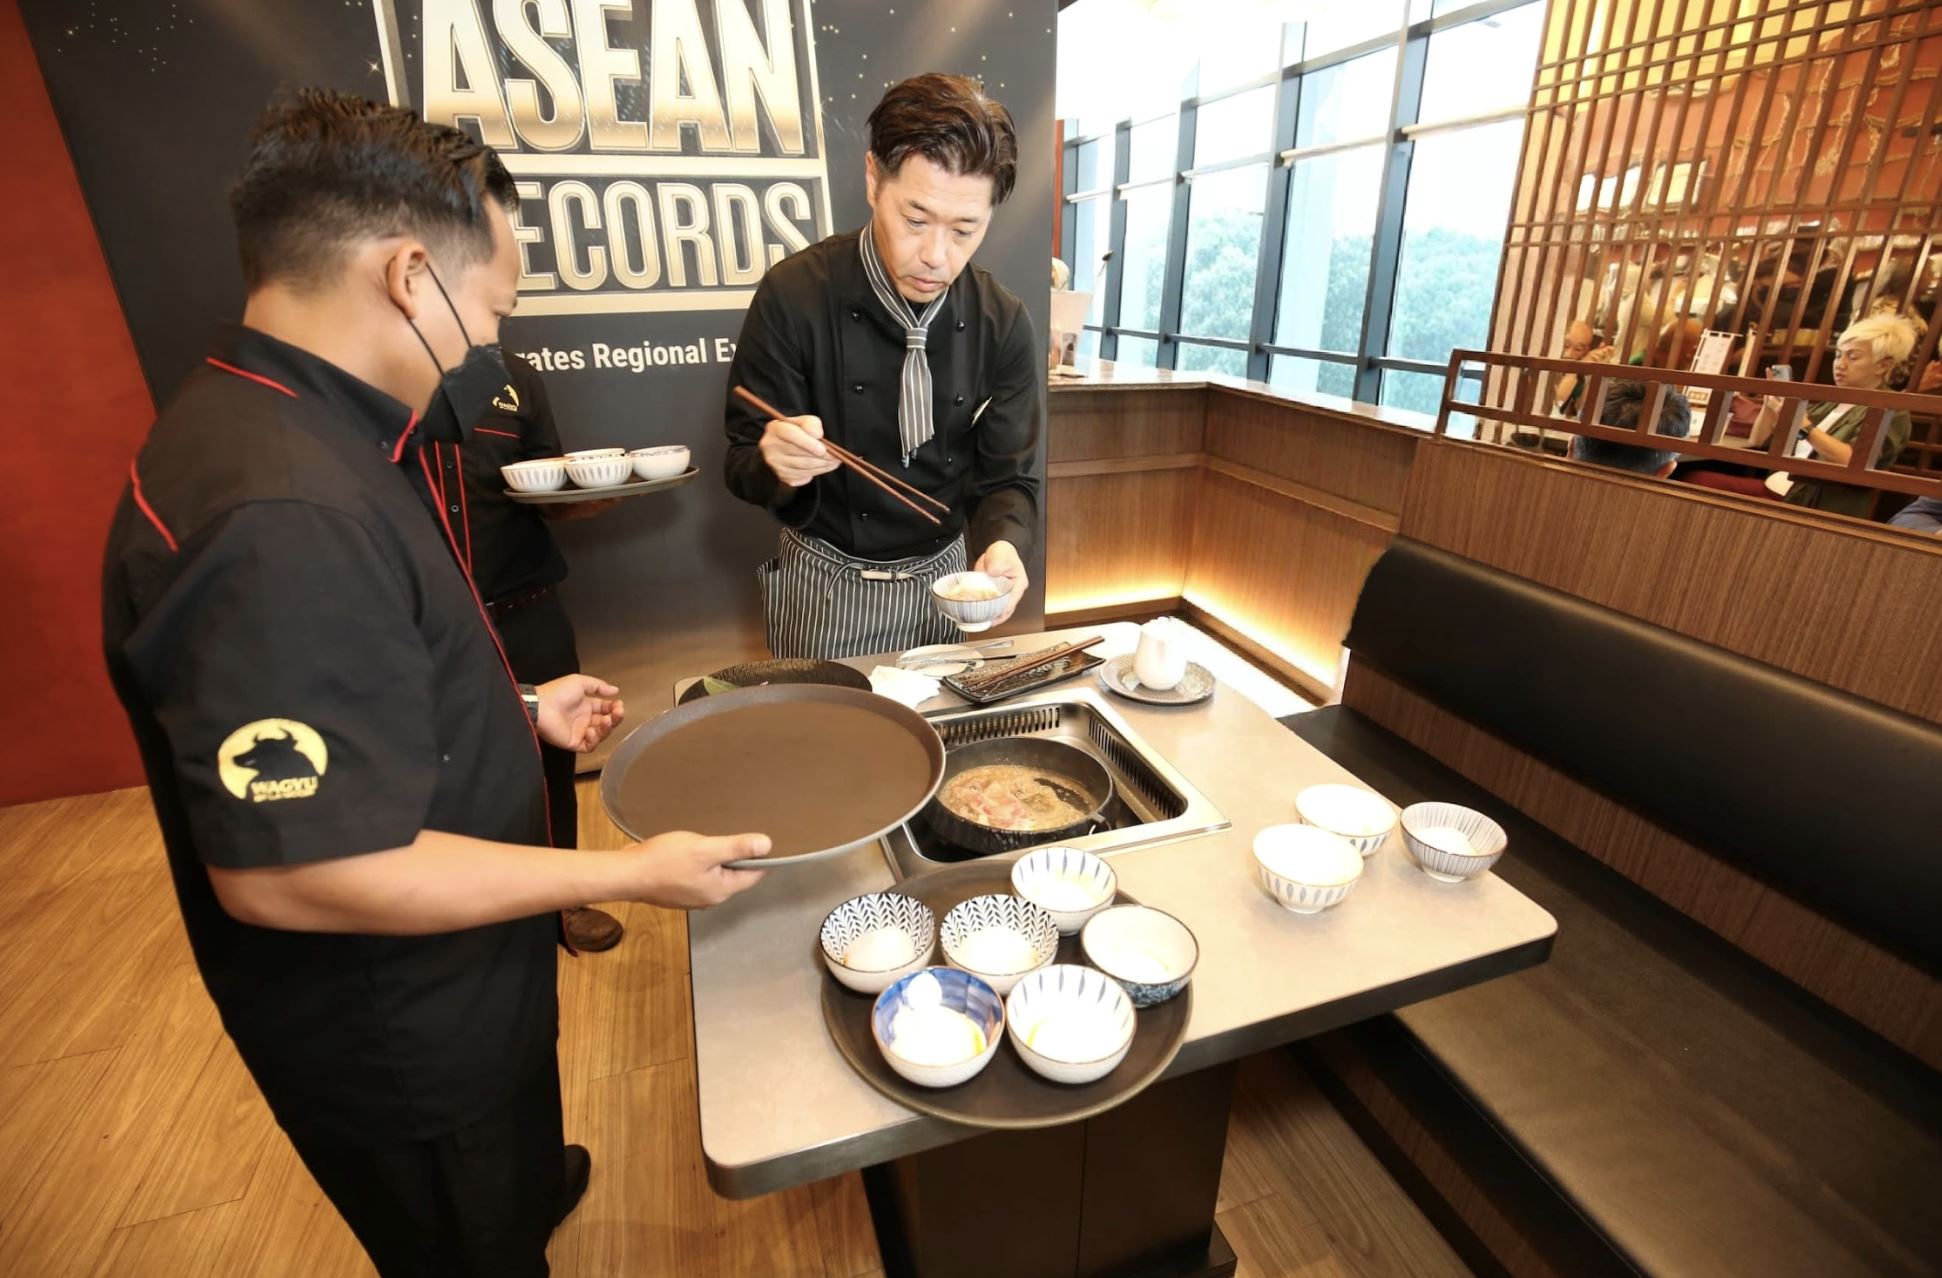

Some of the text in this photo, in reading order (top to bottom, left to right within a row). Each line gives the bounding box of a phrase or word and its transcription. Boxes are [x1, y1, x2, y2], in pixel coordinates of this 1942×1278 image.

[423, 0, 805, 154] ASEAN
[513, 179, 811, 291] ECORDS
[592, 338, 708, 373] Regional
